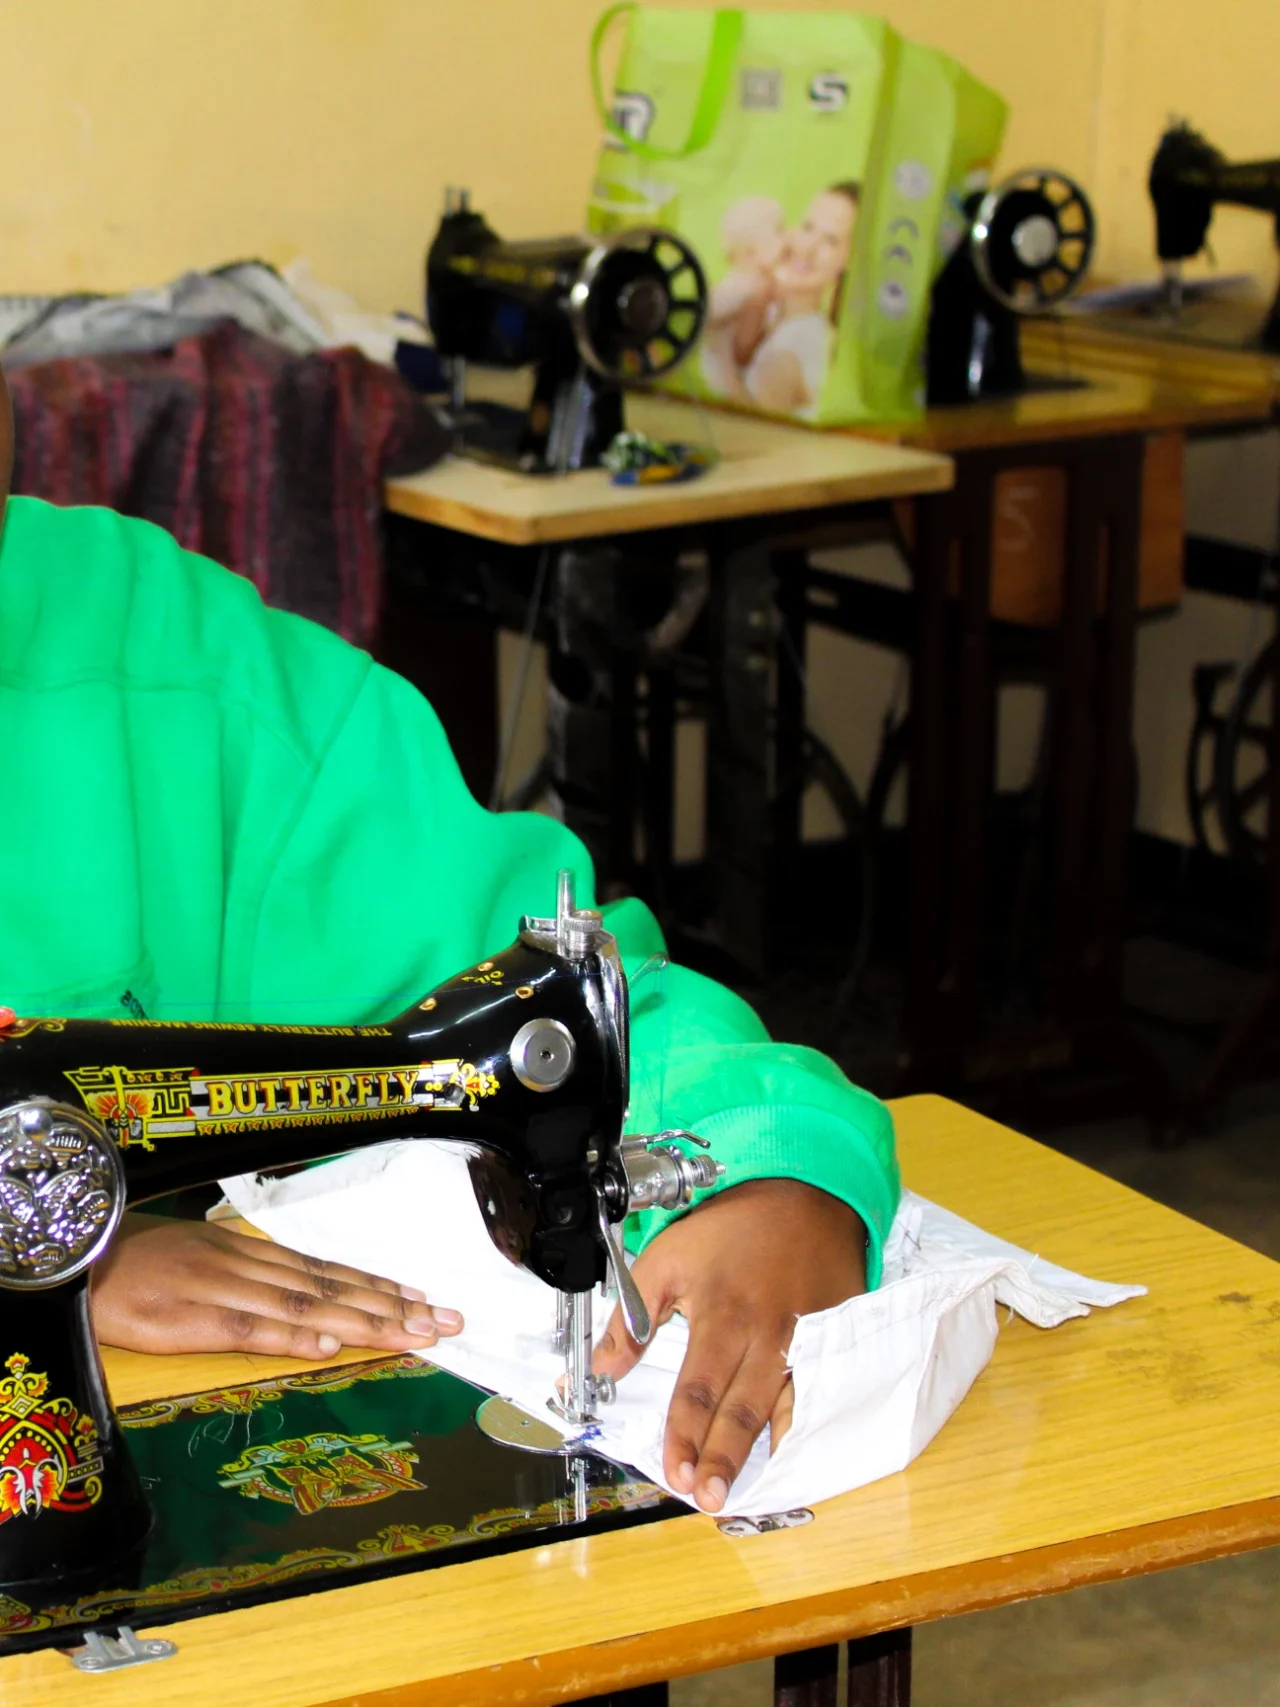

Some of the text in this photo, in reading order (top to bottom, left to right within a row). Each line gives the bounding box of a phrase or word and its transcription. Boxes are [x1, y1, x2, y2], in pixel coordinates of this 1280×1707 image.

[474, 970, 505, 985] OIL
[261, 1023, 356, 1036] BUTTERFLY
[360, 1027, 393, 1036] THE
[206, 1070, 420, 1117] BUTTERFLY
